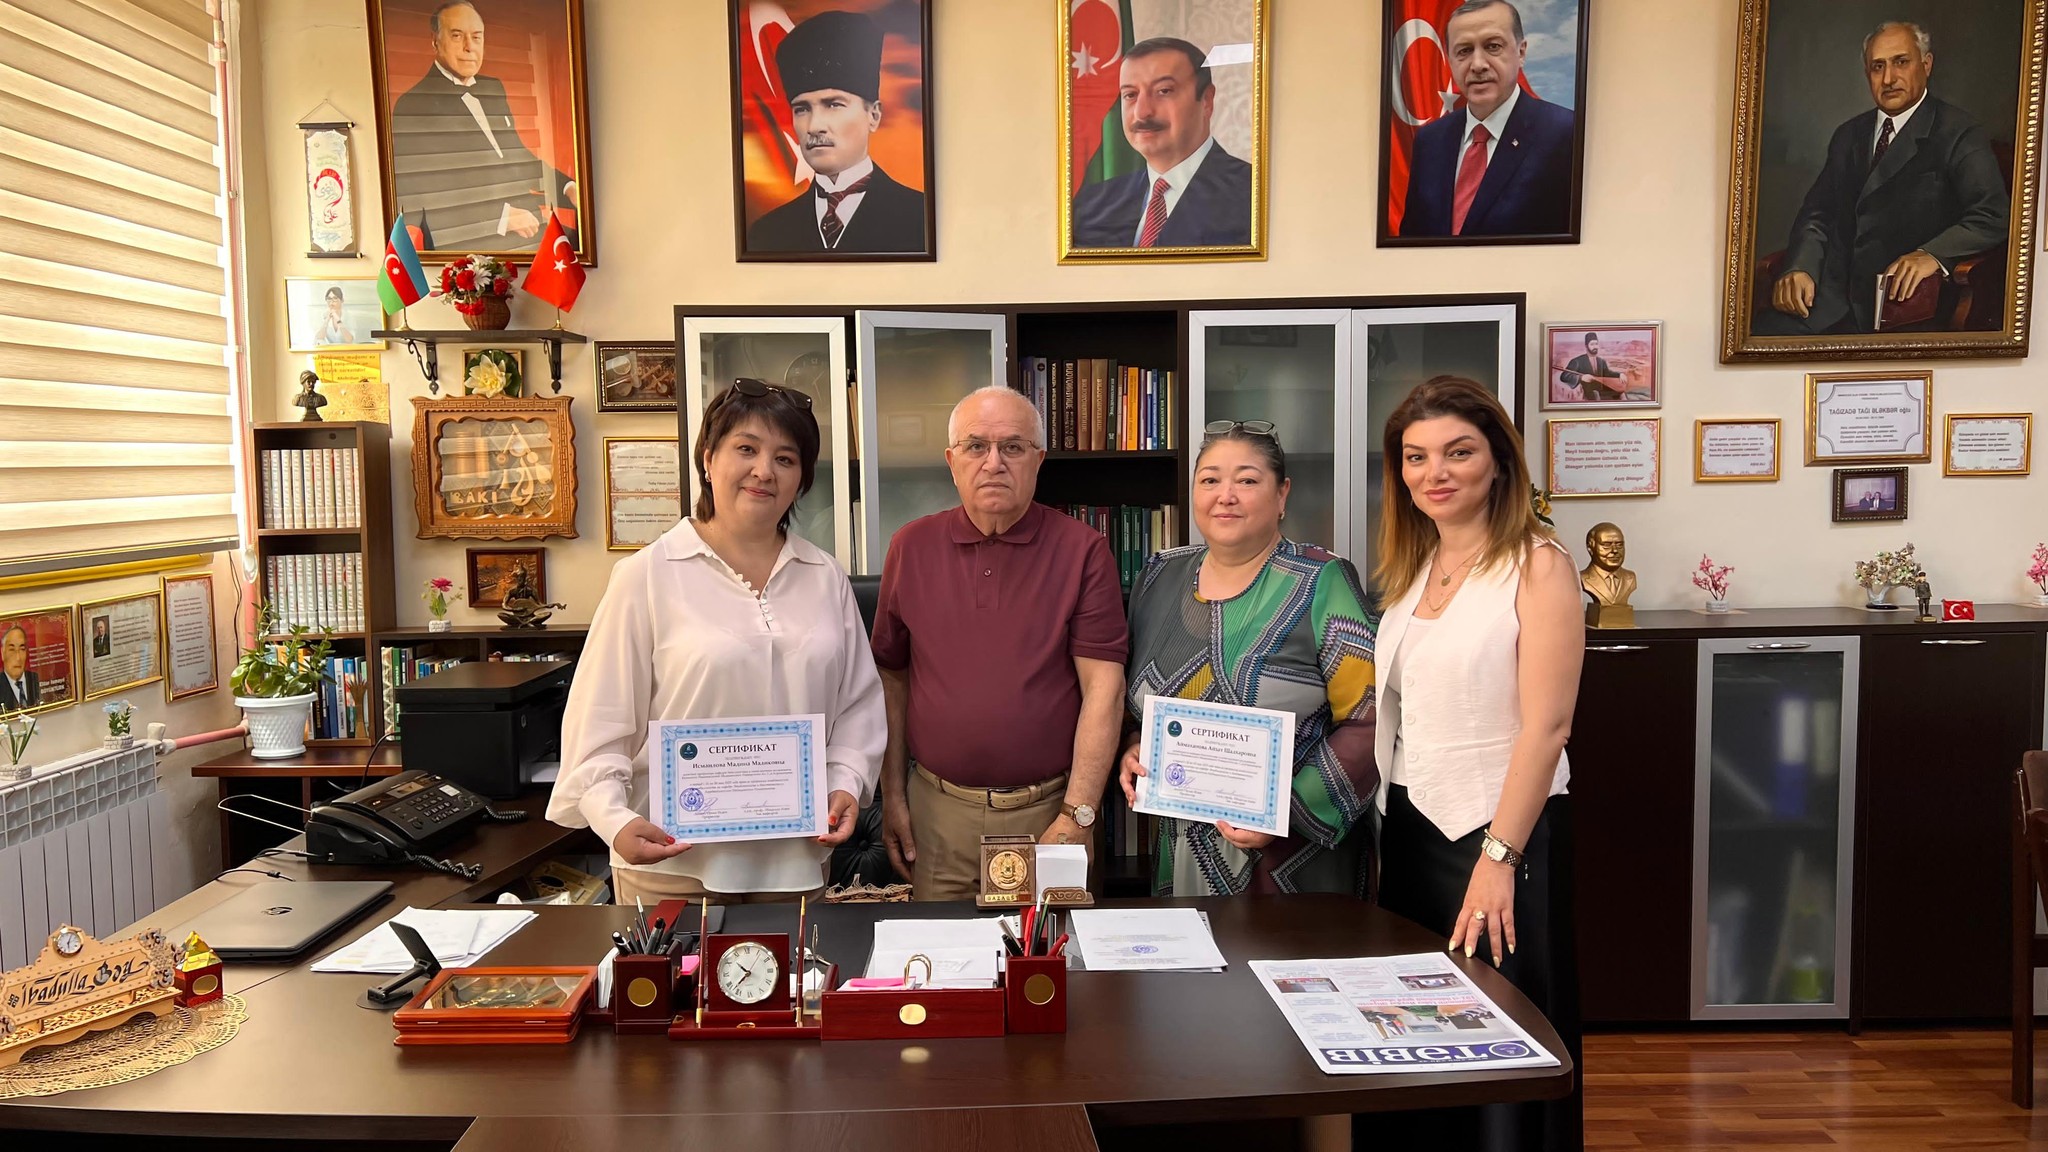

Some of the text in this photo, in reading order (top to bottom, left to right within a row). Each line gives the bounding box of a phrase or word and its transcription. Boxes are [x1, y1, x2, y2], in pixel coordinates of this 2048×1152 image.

[1191, 727, 1250, 743] СЕРТИФИКАТ
[708, 743, 777, 754] СЕРТИФИКАТ
[1325, 1046, 1488, 1065] TƏBİB
